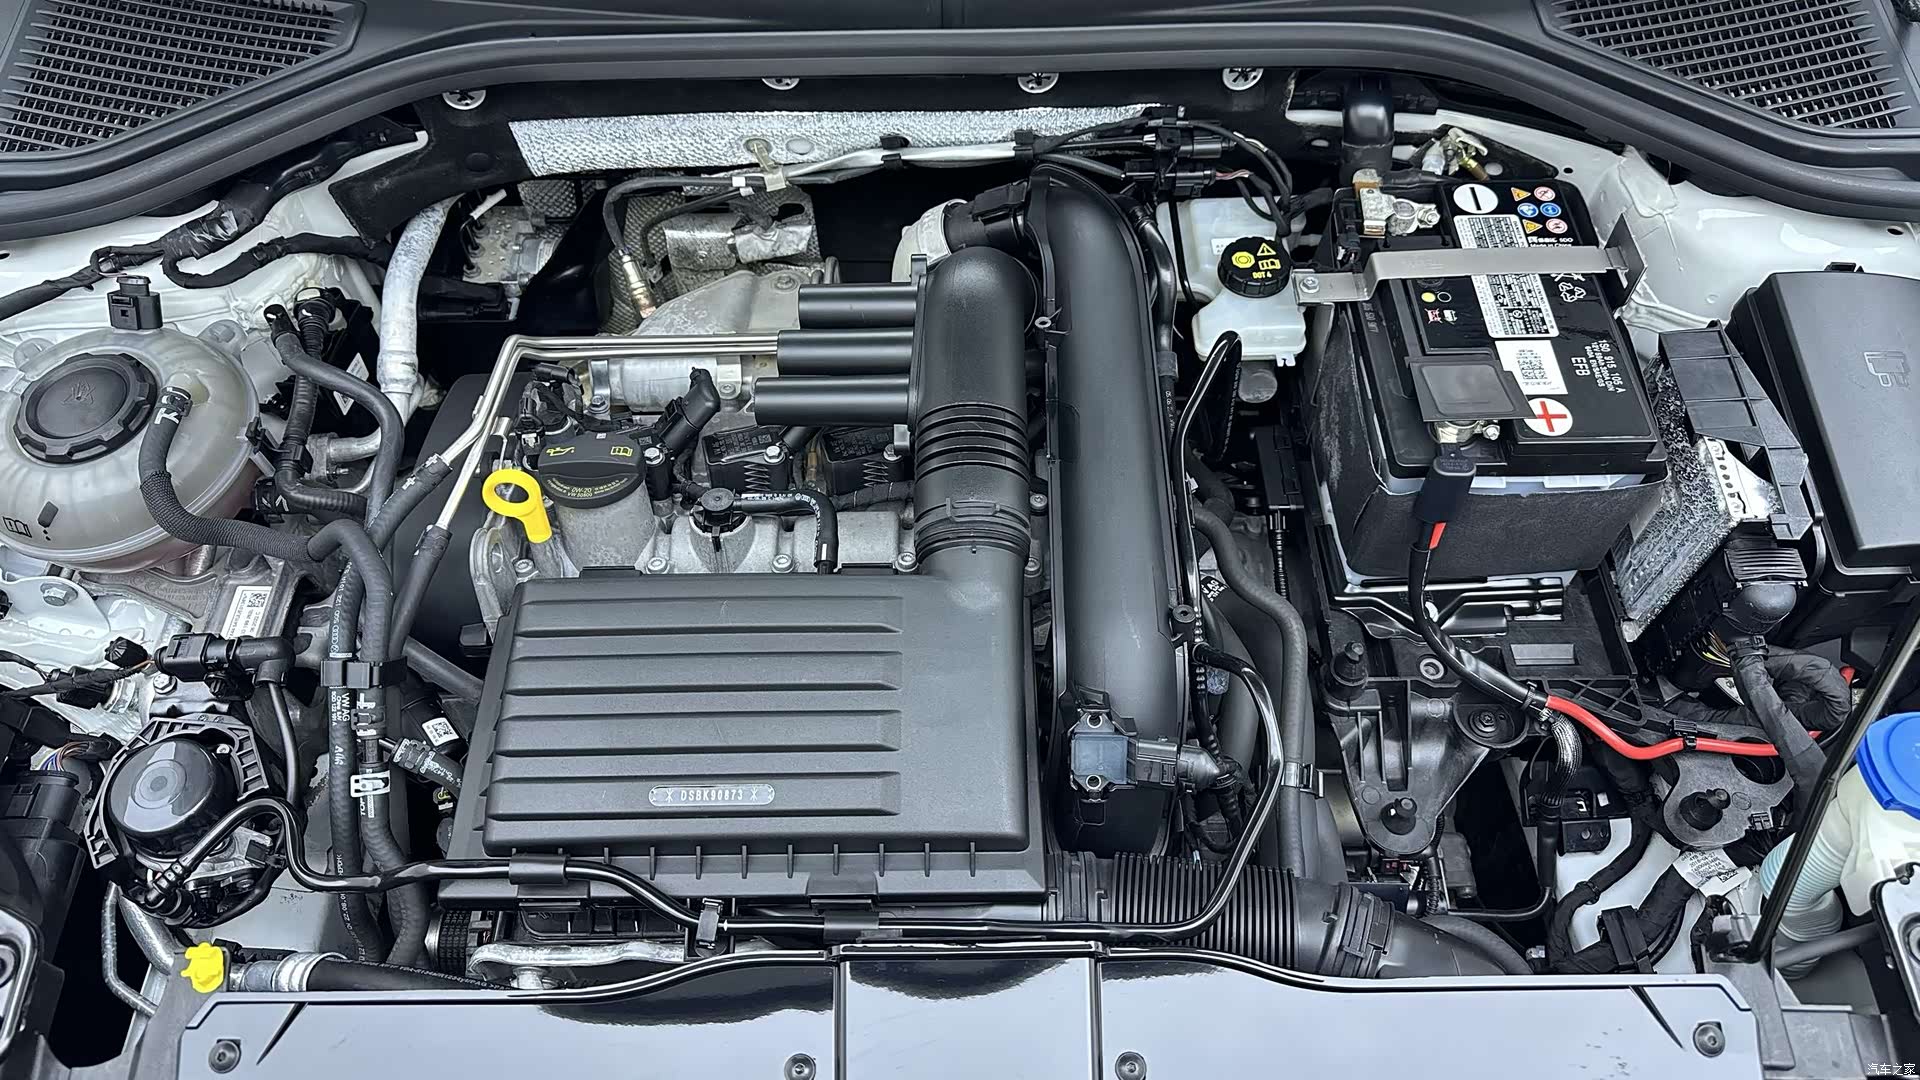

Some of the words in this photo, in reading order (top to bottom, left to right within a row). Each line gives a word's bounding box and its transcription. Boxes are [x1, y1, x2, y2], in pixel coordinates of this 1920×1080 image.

[1252, 271, 1266, 279] DOT
[1571, 357, 1591, 376] EFB
[1604, 355, 1617, 369] 915
[1611, 373, 1623, 386] 105
[342, 692, 350, 708] VW
[342, 709, 350, 722] AG
[680, 789, 743, 801] DSBK90873
